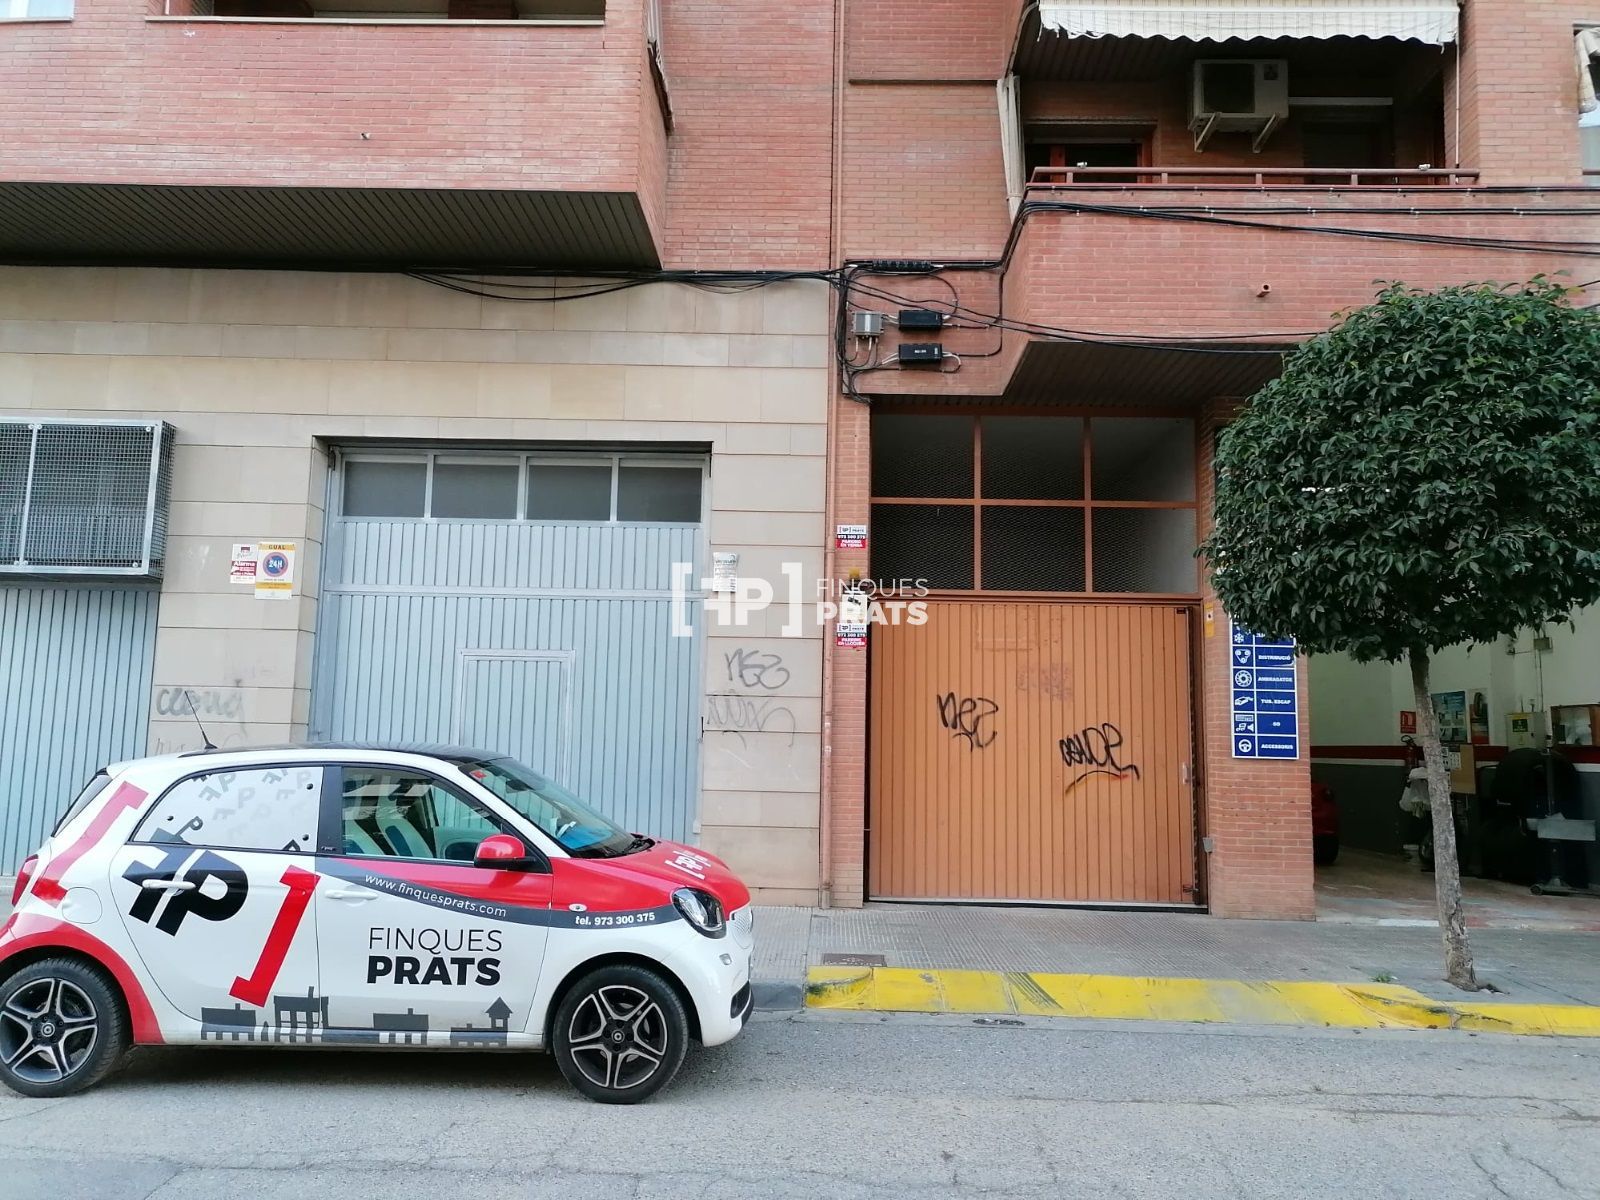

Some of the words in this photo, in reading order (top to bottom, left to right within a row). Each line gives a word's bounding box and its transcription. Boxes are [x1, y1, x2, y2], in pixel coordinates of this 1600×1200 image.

[364, 874, 507, 918] www.finquesprats.com
[575, 915, 592, 926] tel.
[594, 915, 614, 926] 973
[615, 914, 635, 925] 300
[636, 912, 656, 923] 375
[368, 926, 503, 955] FINQUES
[366, 955, 502, 987] PRATS
